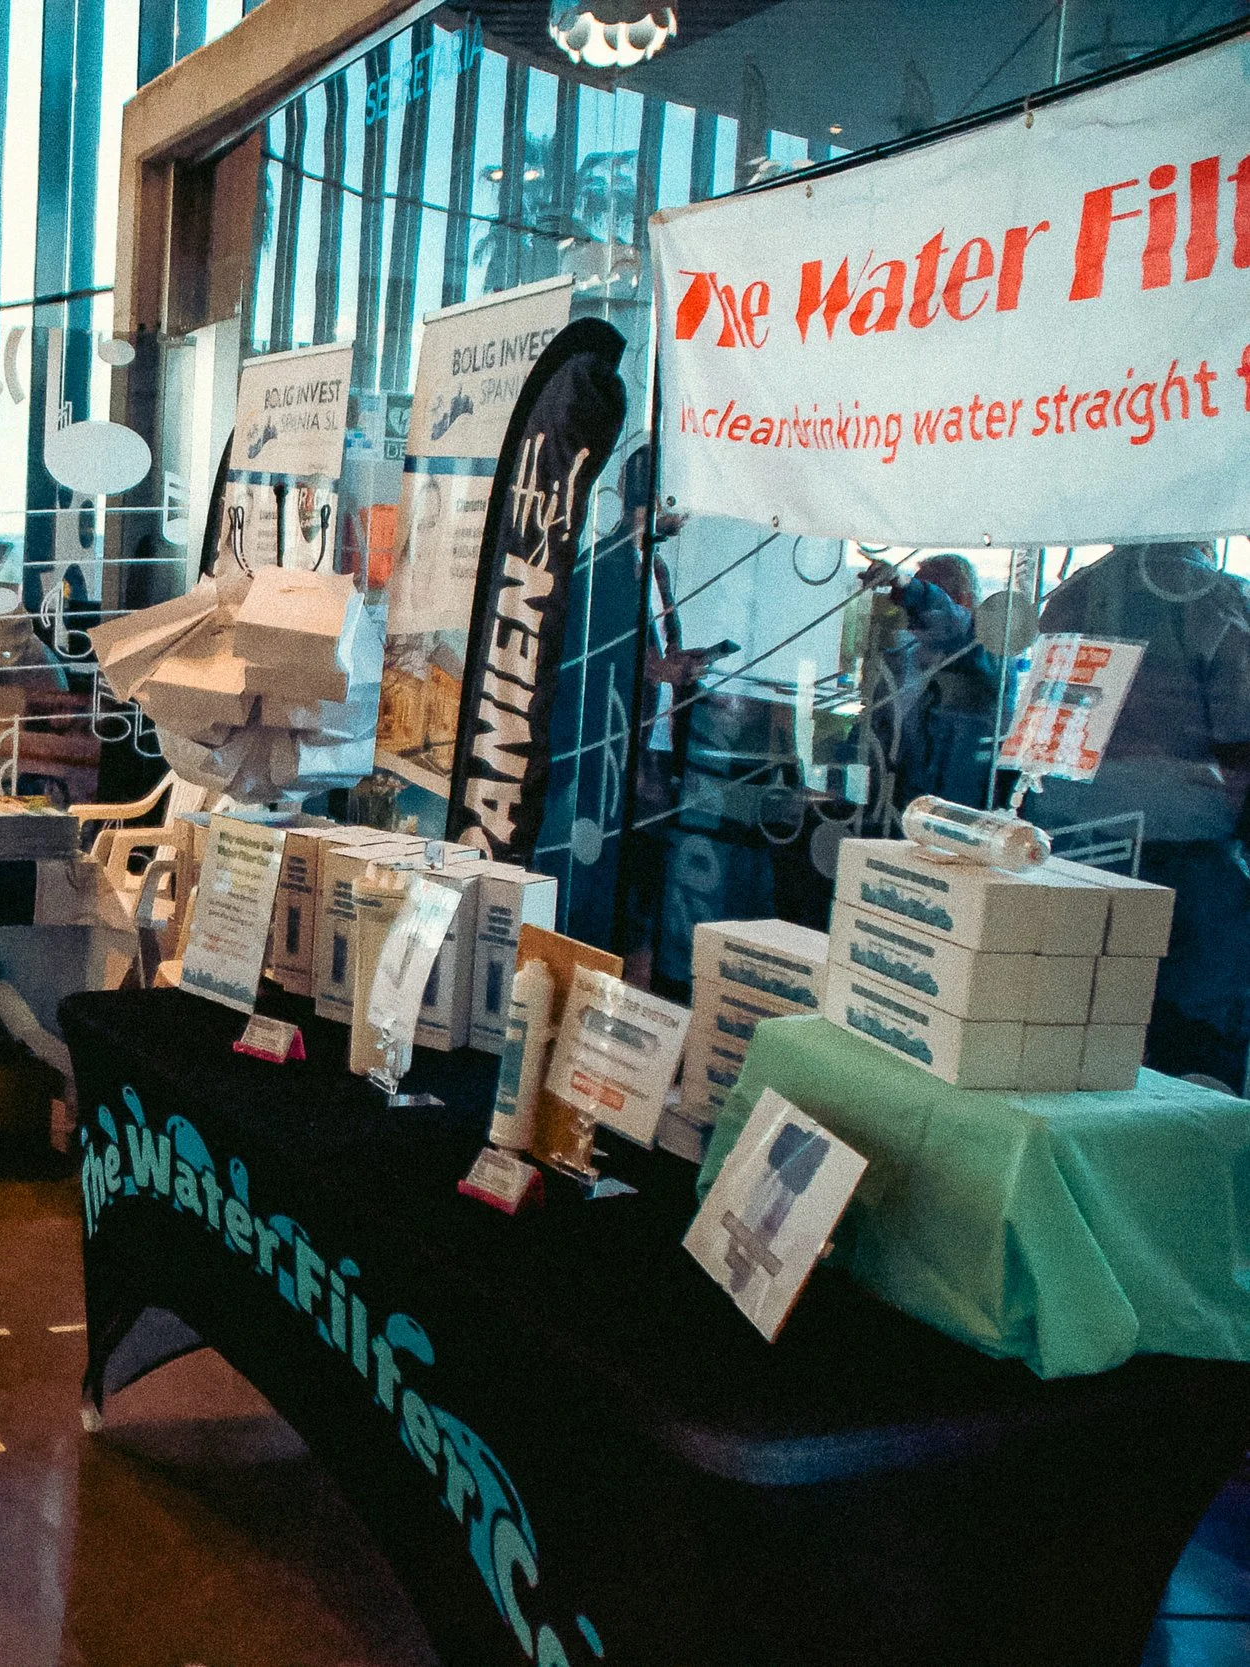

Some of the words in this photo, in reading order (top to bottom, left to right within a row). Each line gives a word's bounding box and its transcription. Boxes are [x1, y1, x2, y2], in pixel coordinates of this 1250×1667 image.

[675, 268, 770, 349] The
[795, 220, 1051, 345] Water
[296, 379, 343, 405] INVEST
[452, 340, 496, 376] BOLIG
[500, 327, 558, 367] INVES
[481, 374, 529, 406] SPANI
[913, 394, 1024, 446] water
[1031, 358, 1220, 446] straight
[456, 552, 554, 863] PANIEN
[82, 1142, 123, 1240] The
[125, 1124, 280, 1277] Water
[295, 1234, 477, 1524] Filter
